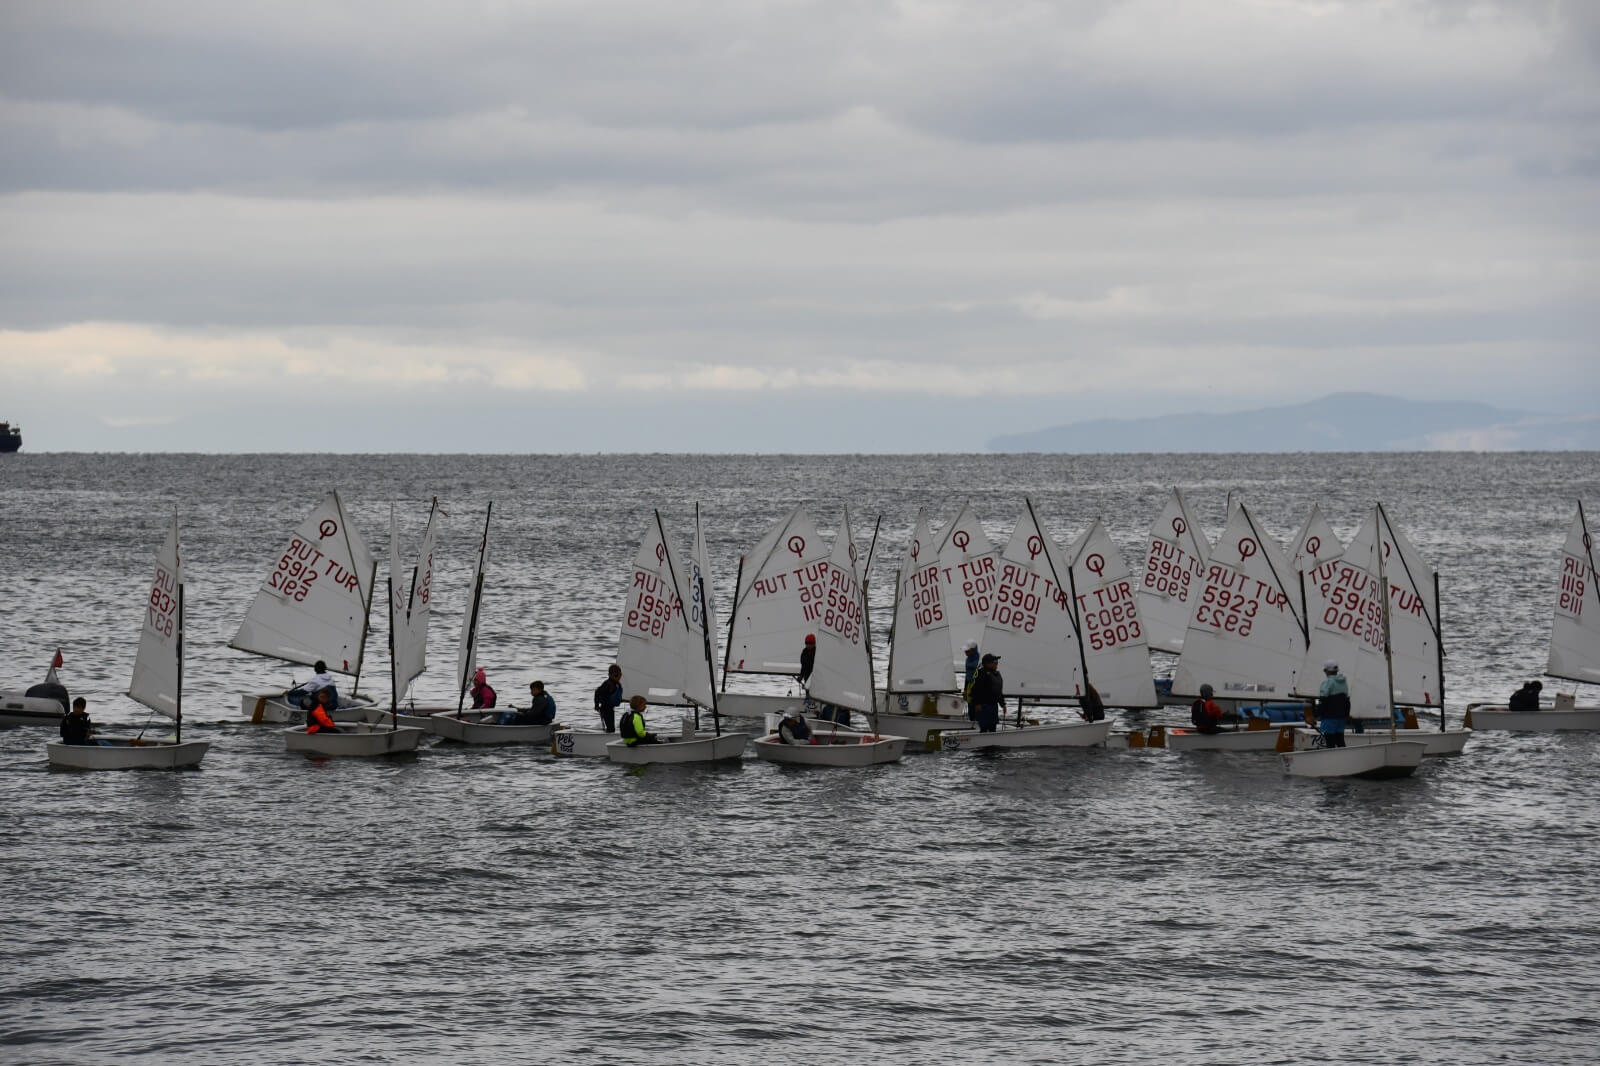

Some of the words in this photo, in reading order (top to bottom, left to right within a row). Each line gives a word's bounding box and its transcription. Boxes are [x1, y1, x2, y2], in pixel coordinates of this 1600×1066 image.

[278, 554, 318, 588] 5912
[325, 560, 359, 593] TUR
[911, 567, 939, 591] TUR
[958, 557, 996, 580] TUR
[1148, 556, 1191, 586] 5909
[1189, 556, 1206, 578] TU
[151, 587, 176, 616] 837
[637, 592, 671, 622] 1959
[828, 588, 861, 625] 5908
[966, 594, 993, 616] 110
[998, 585, 1041, 615] 5901
[1093, 581, 1133, 607] TUR
[1202, 585, 1258, 618] 5923
[1256, 581, 1288, 613] TUR
[1390, 585, 1423, 617] TUR
[915, 603, 943, 630] 1105
[1090, 621, 1141, 650] 5903
